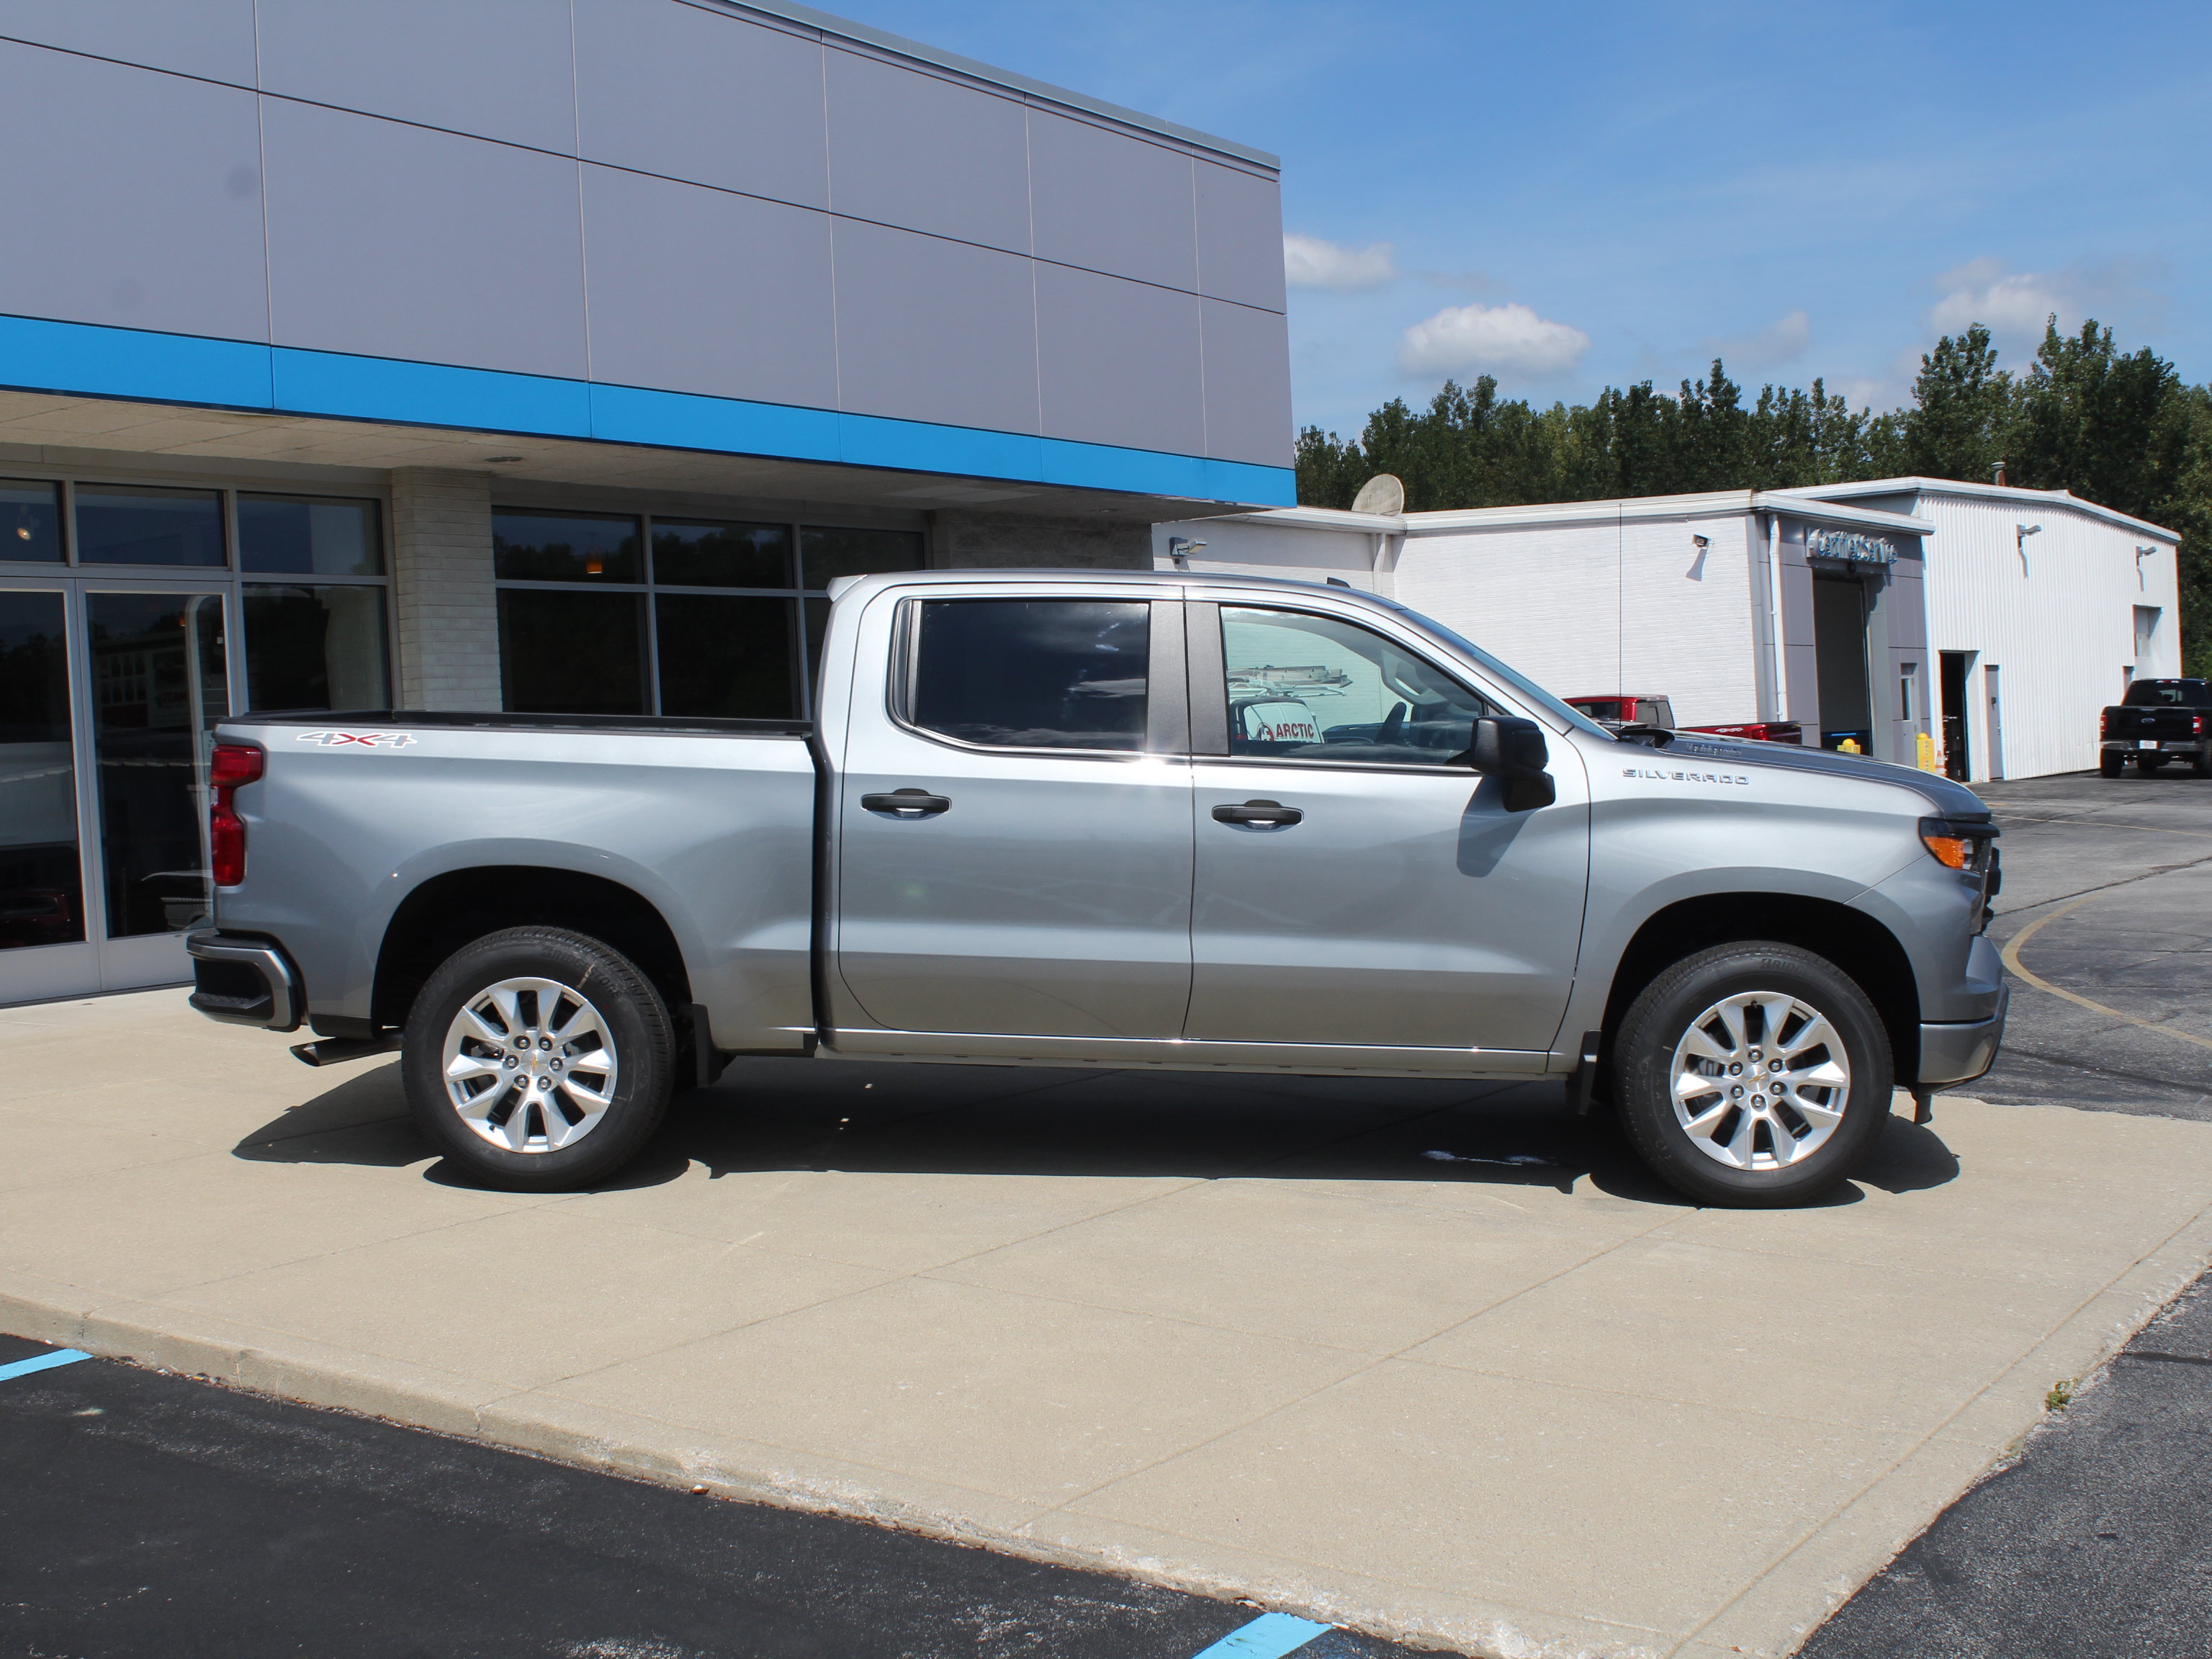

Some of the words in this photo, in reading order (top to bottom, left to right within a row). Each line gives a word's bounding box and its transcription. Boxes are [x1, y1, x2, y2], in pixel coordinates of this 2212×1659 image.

[1807, 529, 1861, 560] Certified
[1860, 534, 1898, 565] Service
[1276, 723, 1315, 738] ARCTIC
[1622, 768, 1750, 785] SILVERADO
